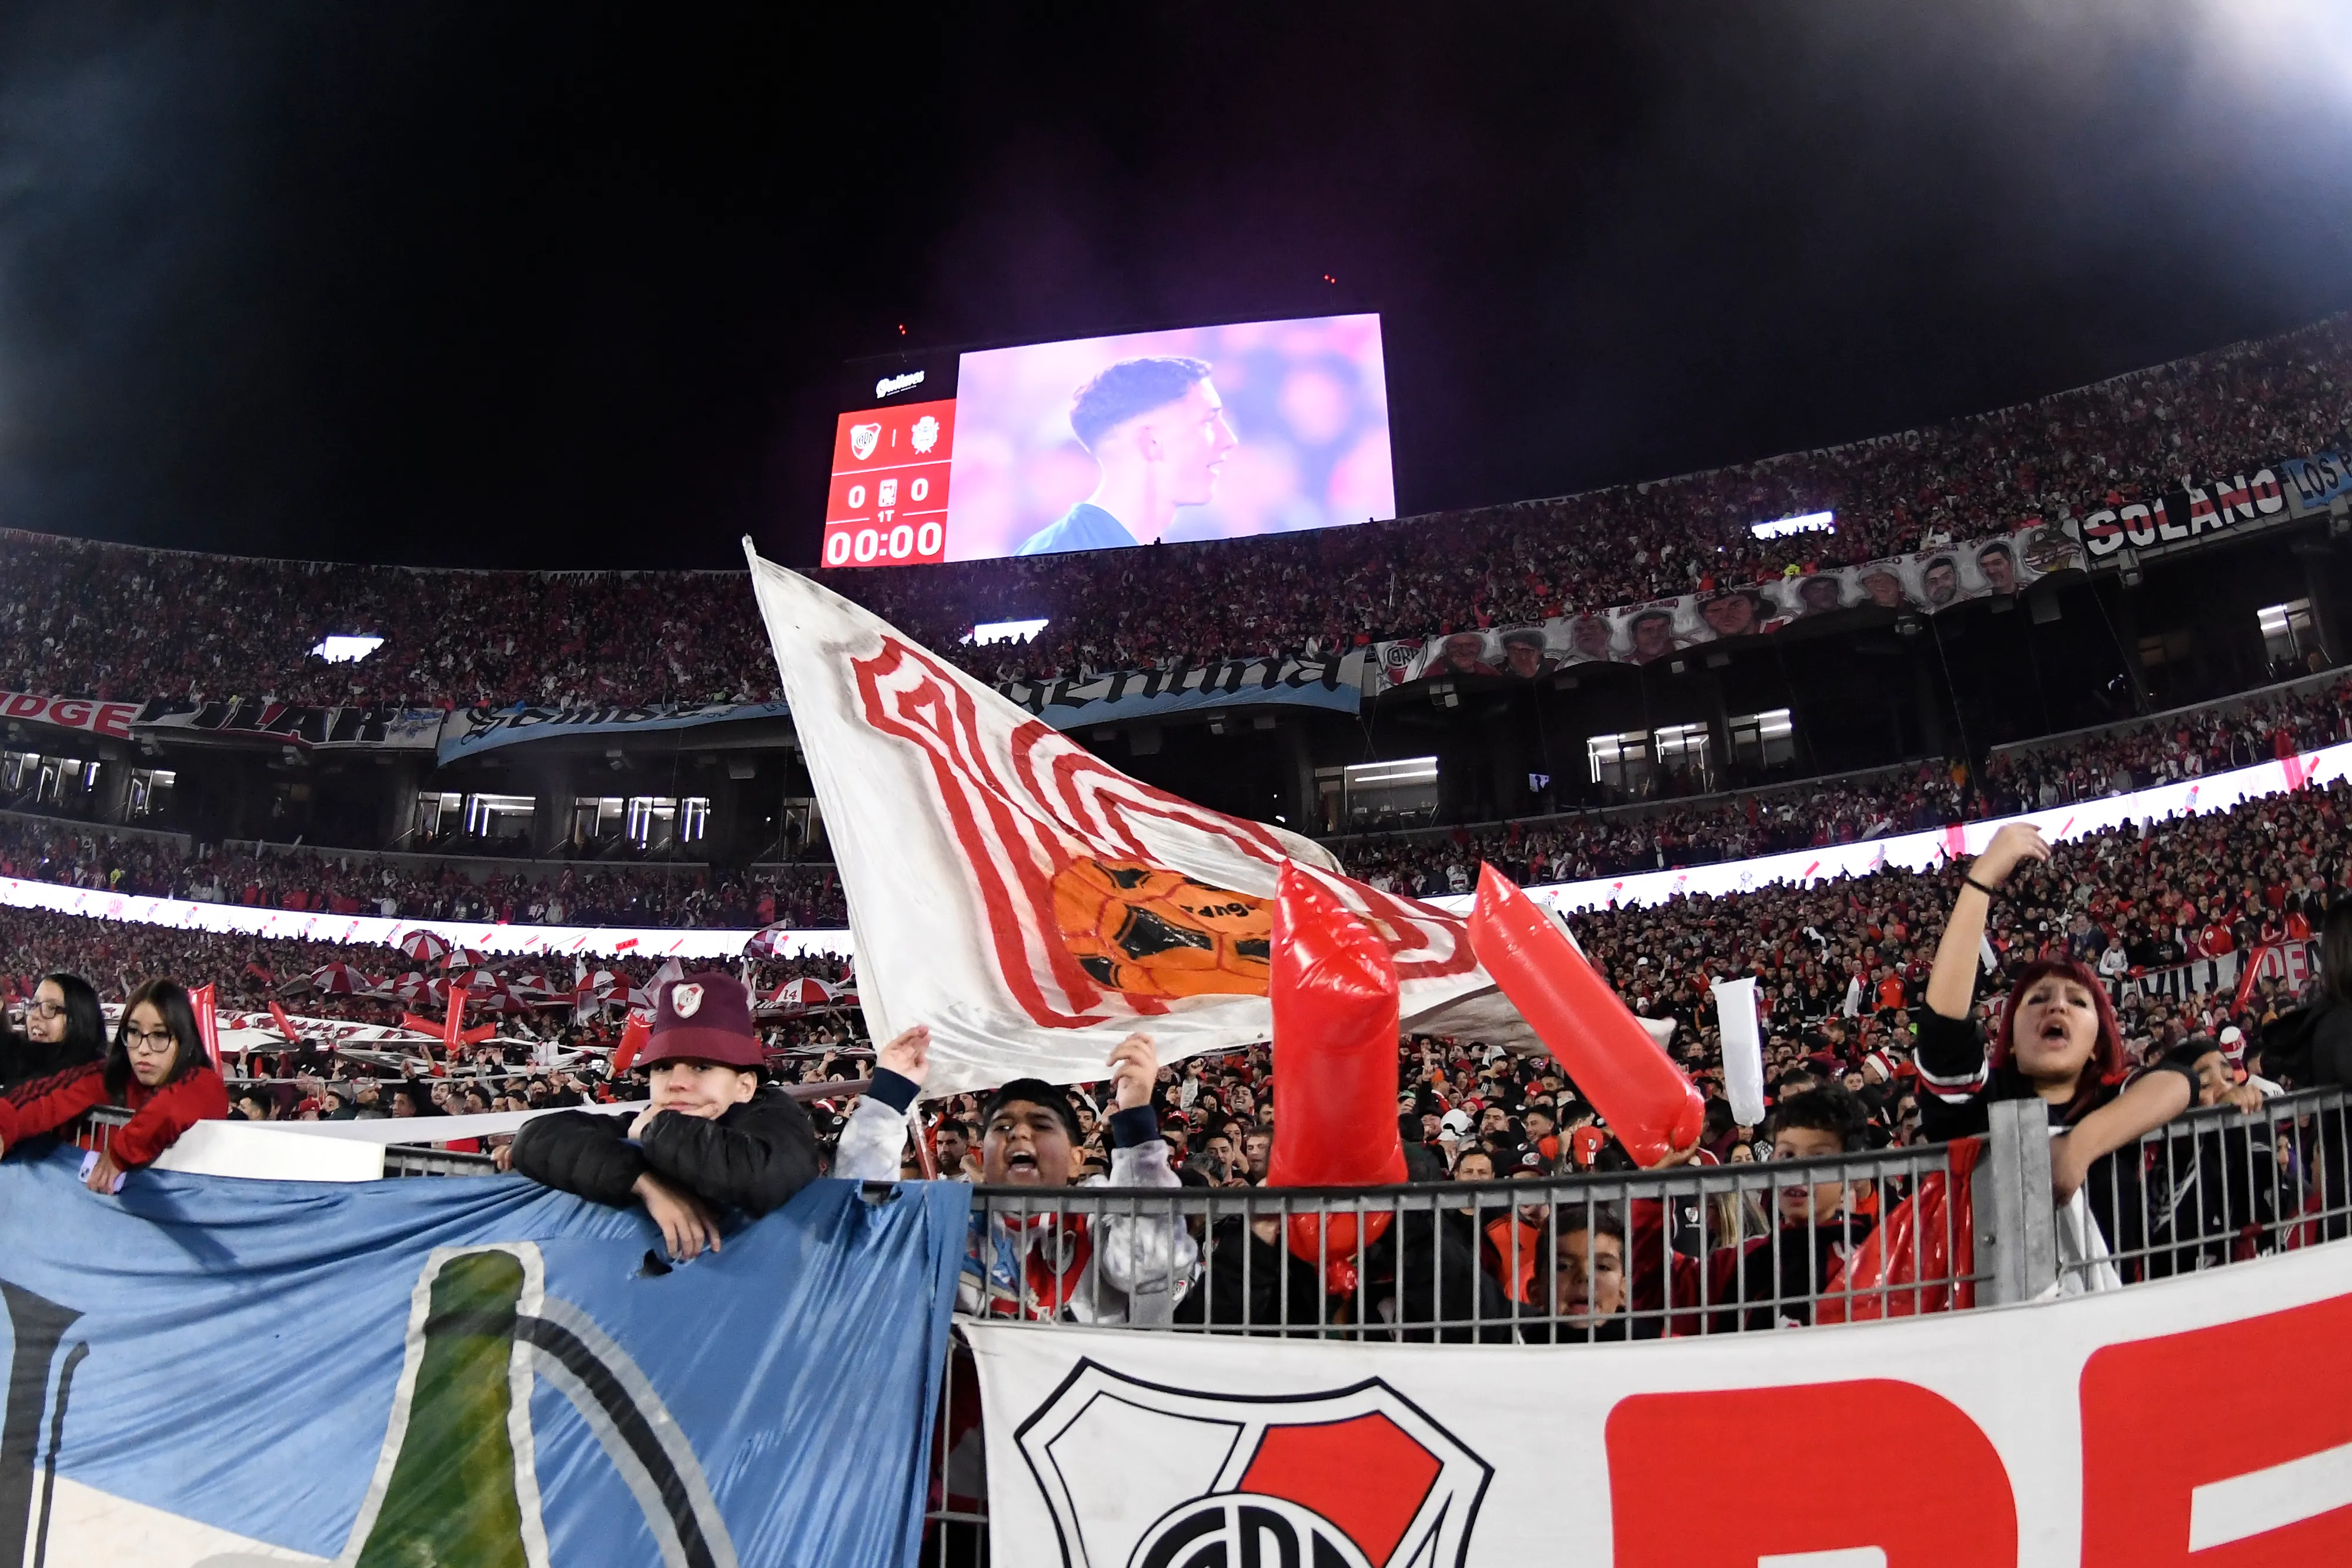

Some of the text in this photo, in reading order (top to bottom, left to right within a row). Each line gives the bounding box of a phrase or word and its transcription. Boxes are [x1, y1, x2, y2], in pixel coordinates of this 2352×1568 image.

[911, 478, 928, 502] 0
[2288, 457, 2339, 500] LOS
[848, 485, 866, 509] 0
[878, 510, 894, 523] 1T
[2083, 469, 2283, 556] SOLANO
[827, 522, 942, 565] 00:00
[783, 989, 797, 1000] 14
